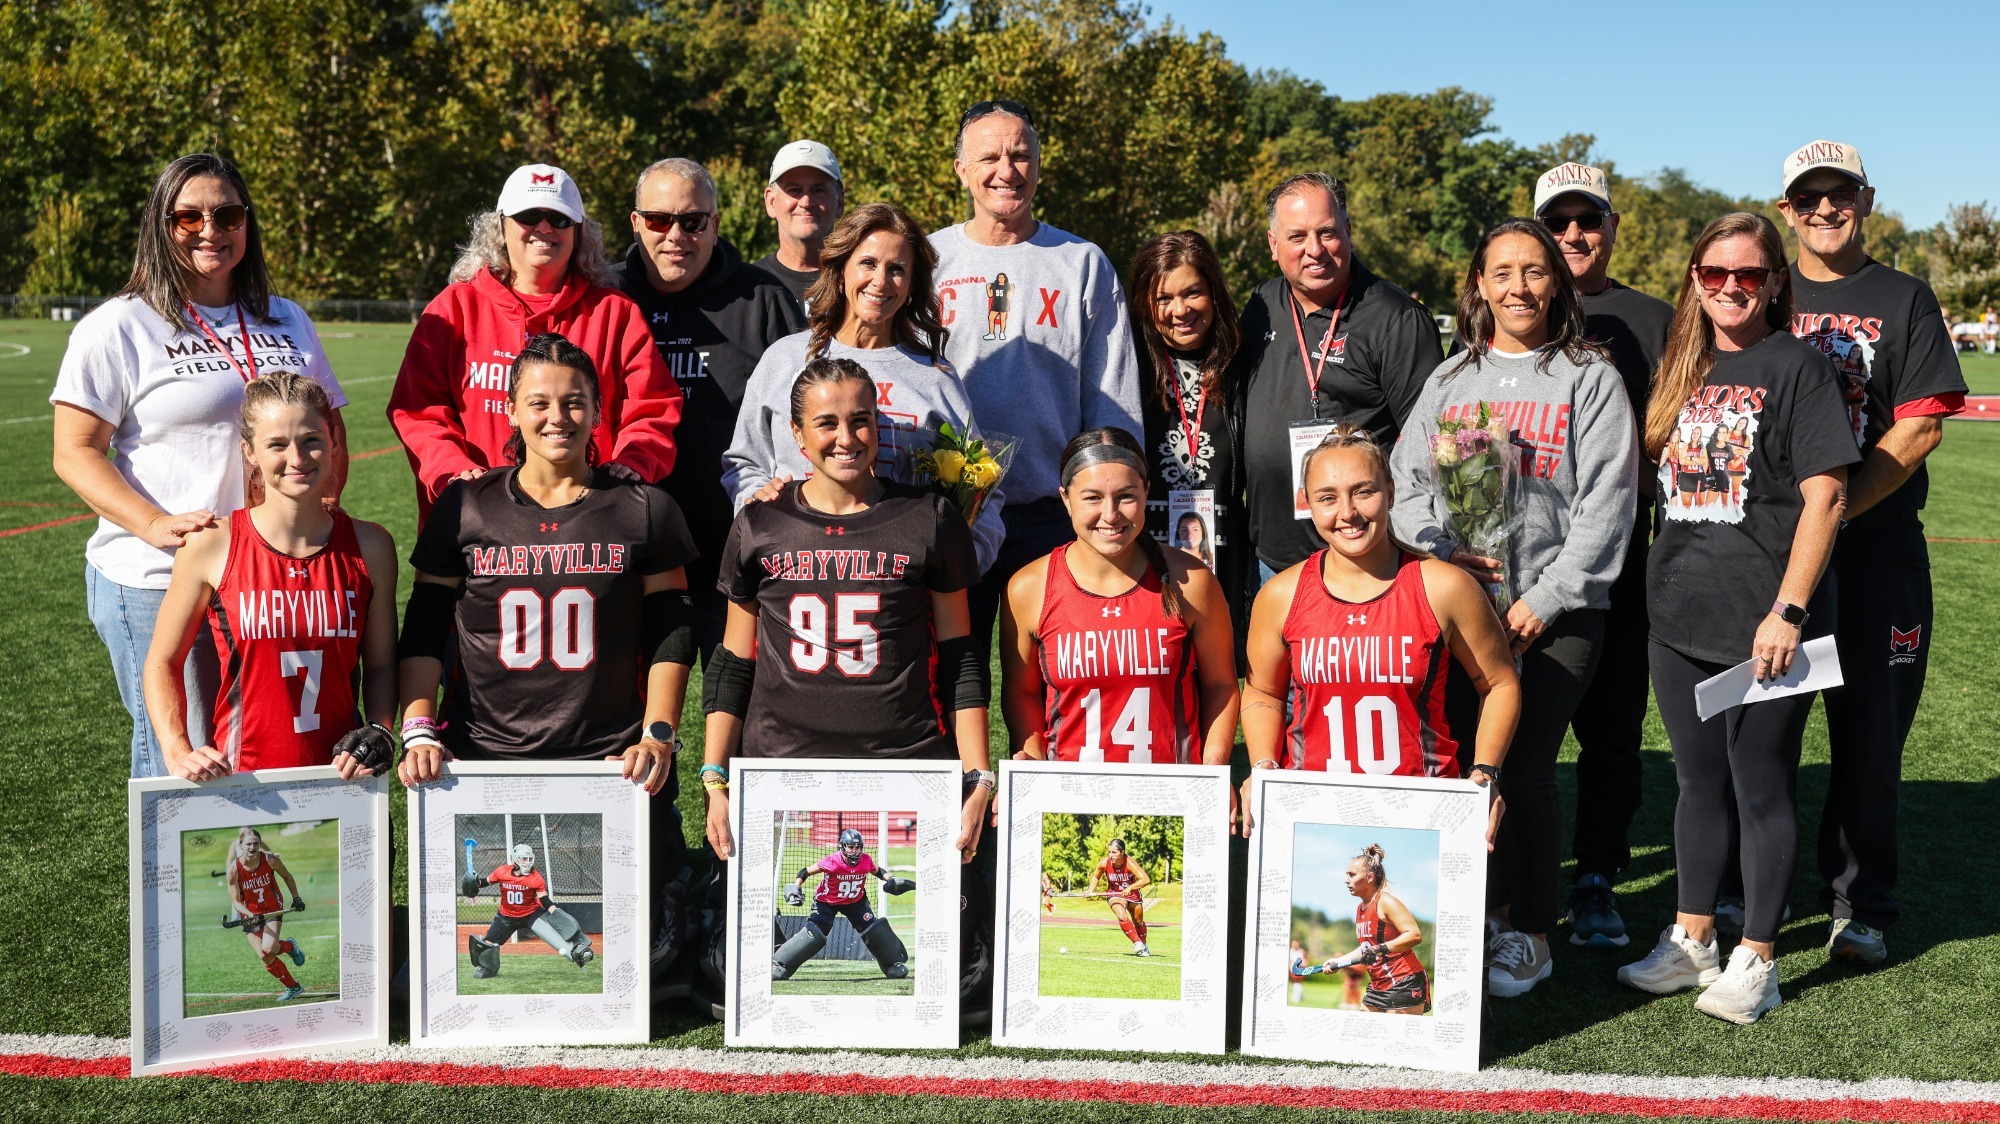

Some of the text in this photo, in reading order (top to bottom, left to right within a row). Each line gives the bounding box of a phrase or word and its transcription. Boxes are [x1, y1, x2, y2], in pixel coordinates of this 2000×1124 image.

[1796, 143, 1844, 167] SAINTS
[1823, 157, 1844, 165] HOCKEY
[1547, 164, 1592, 188] SAINTS
[1572, 179, 1592, 187] HOCKEY
[938, 276, 987, 289] JOANNA
[995, 289, 1004, 297] 95
[174, 354, 308, 376] FIELD HOCKEY
[1682, 407, 1725, 424] 2026
[1714, 457, 1726, 471] 95
[473, 543, 625, 576] MARYVILLE
[761, 549, 910, 581] MARYVILLE
[239, 589, 358, 641] MARYVILLE
[497, 586, 597, 672] 00
[788, 591, 881, 678] 95
[1057, 628, 1171, 680] MARYVILLE
[1301, 635, 1414, 685] MARYVILLE
[280, 649, 324, 734] 7
[1079, 687, 1153, 765] 14
[1323, 695, 1402, 775] 10
[242, 873, 271, 890] MARYVILLE
[837, 880, 864, 899] 95
[252, 887, 265, 904] 7
[506, 890, 524, 905] 00
